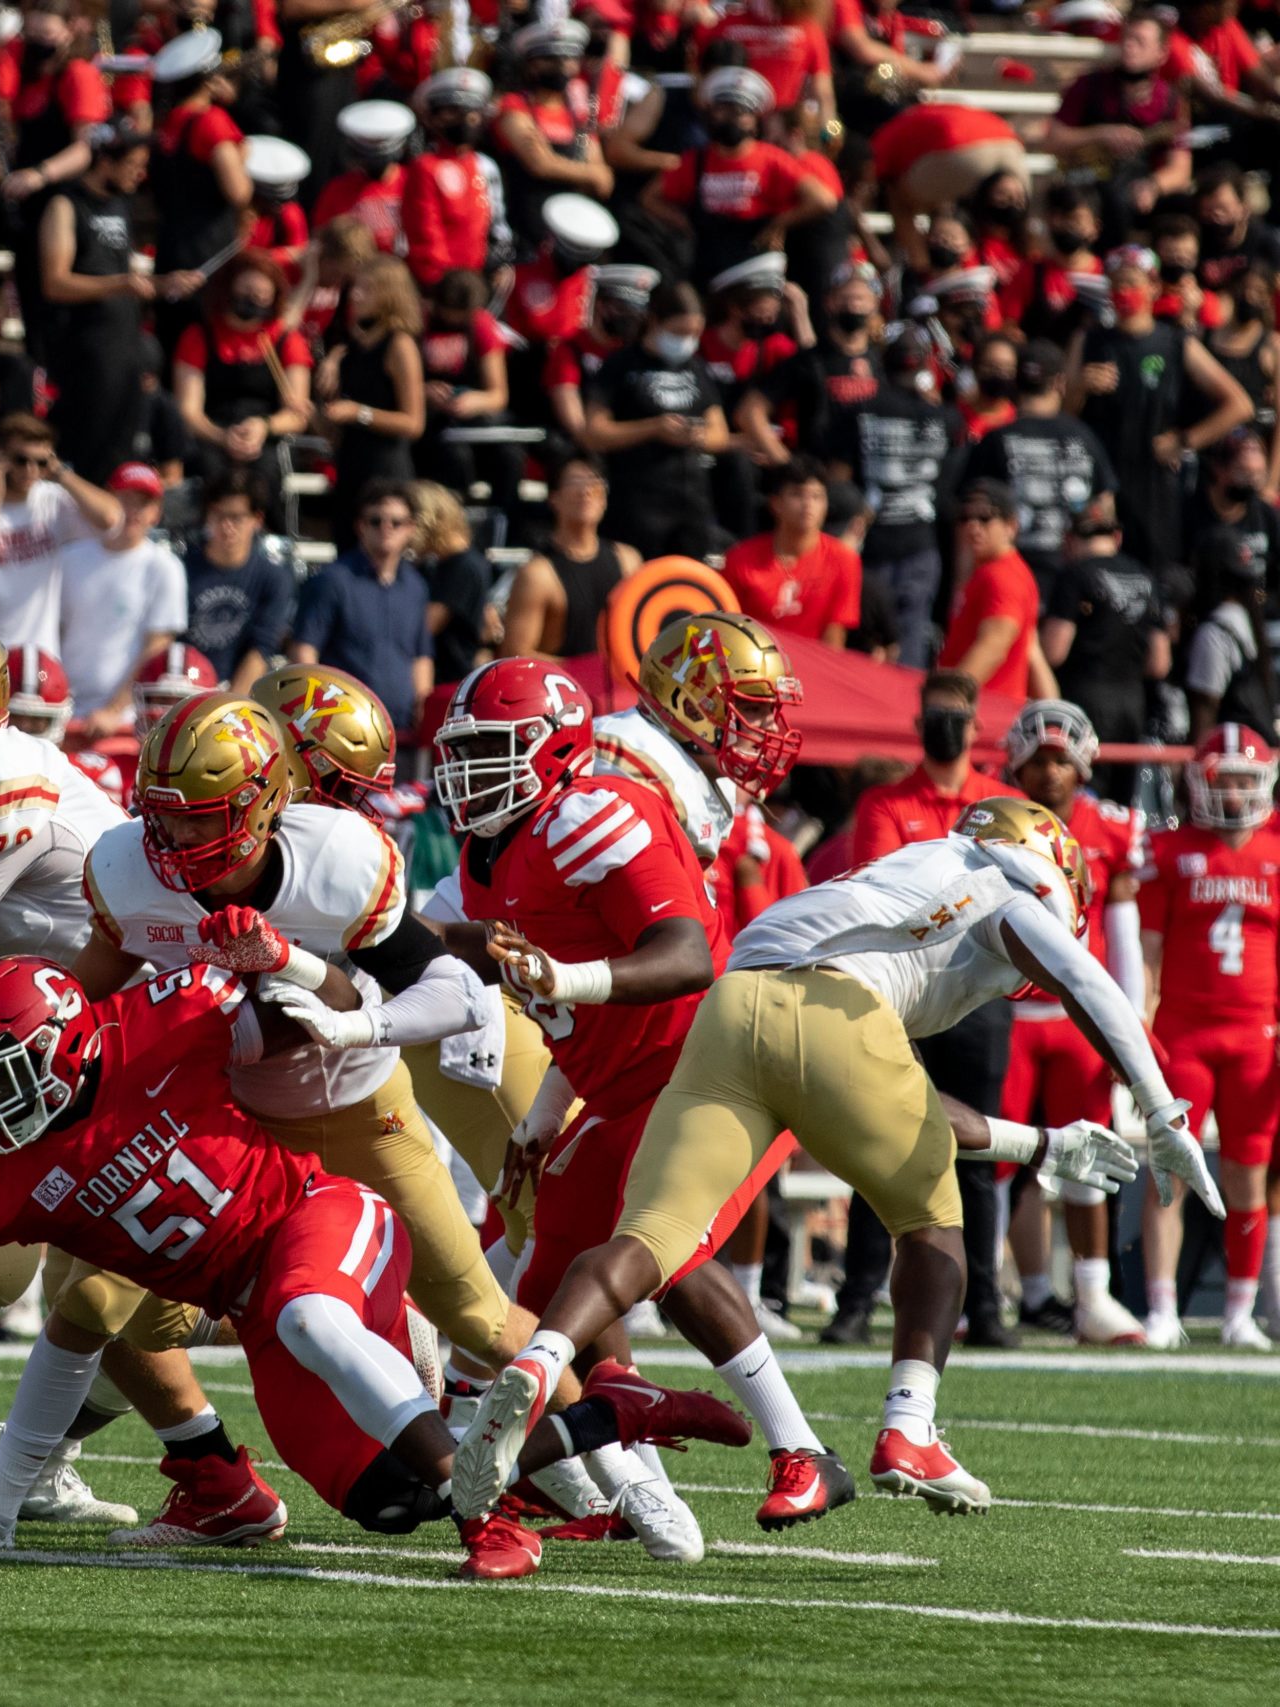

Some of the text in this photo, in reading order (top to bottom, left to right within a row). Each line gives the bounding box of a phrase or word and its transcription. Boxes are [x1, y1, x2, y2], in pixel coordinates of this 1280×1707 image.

[543, 673, 585, 726] C
[1190, 876, 1272, 907] CORNELL
[146, 925, 185, 944] SOCON
[1208, 902, 1246, 976] 4
[45, 1171, 67, 1198] IVY
[75, 1109, 190, 1218] CORNELL
[110, 1147, 234, 1261] 51
